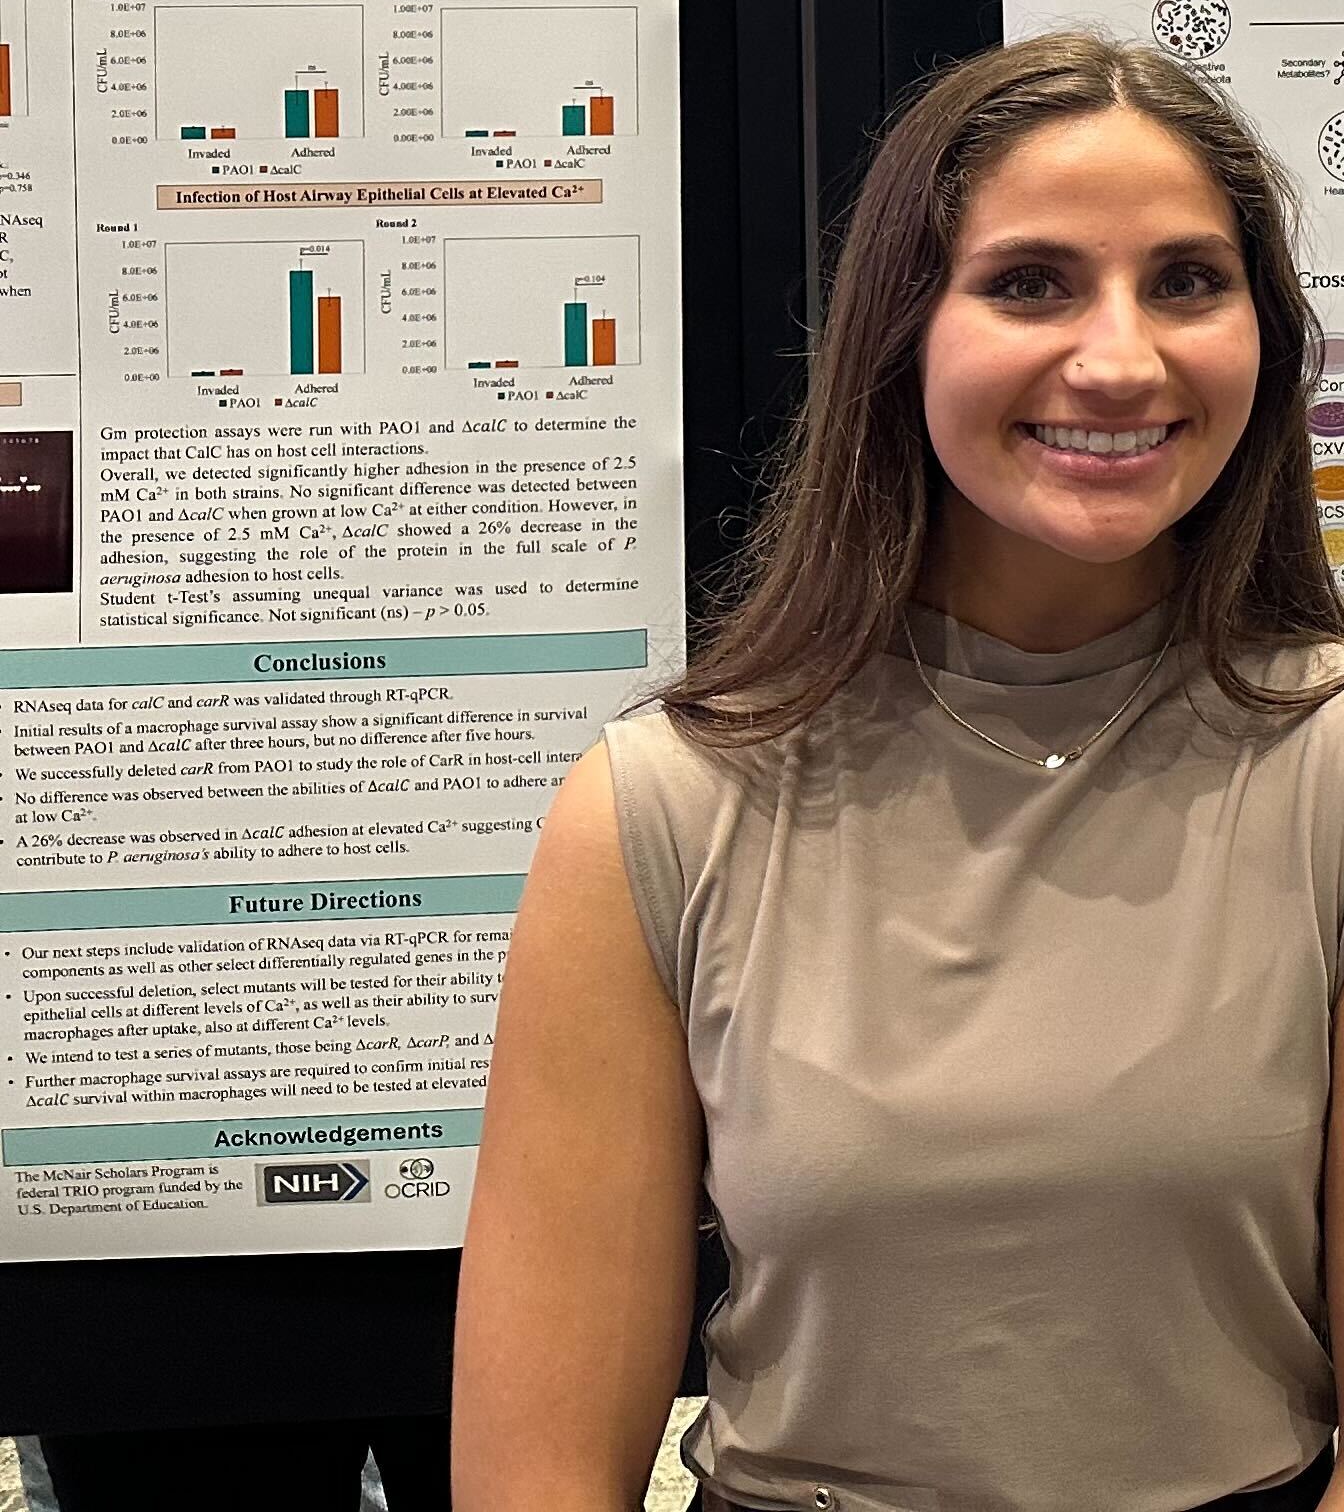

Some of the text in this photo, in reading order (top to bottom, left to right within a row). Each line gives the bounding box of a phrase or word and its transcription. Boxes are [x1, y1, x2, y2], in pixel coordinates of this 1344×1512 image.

[175, 190, 241, 205] Infection
[244, 189, 261, 204] of
[262, 189, 298, 203] Host
[299, 188, 353, 205] Airway
[356, 186, 426, 204] Epithelial
[429, 186, 465, 201] Cells
[468, 187, 484, 200] at
[486, 185, 548, 200] Elevated
[252, 652, 387, 674] Conclusions
[13, 700, 72, 716] RNAseq
[75, 698, 105, 712] data
[108, 697, 129, 711] for
[131, 695, 165, 710] calC
[167, 695, 193, 709] and
[196, 694, 230, 708] carR
[233, 696, 260, 707] was
[263, 690, 326, 706] validated
[329, 689, 382, 706] through
[228, 889, 422, 914] Future Directions
[214, 1122, 443, 1148] Acknowledgements
[272, 1172, 340, 1194] NIH
